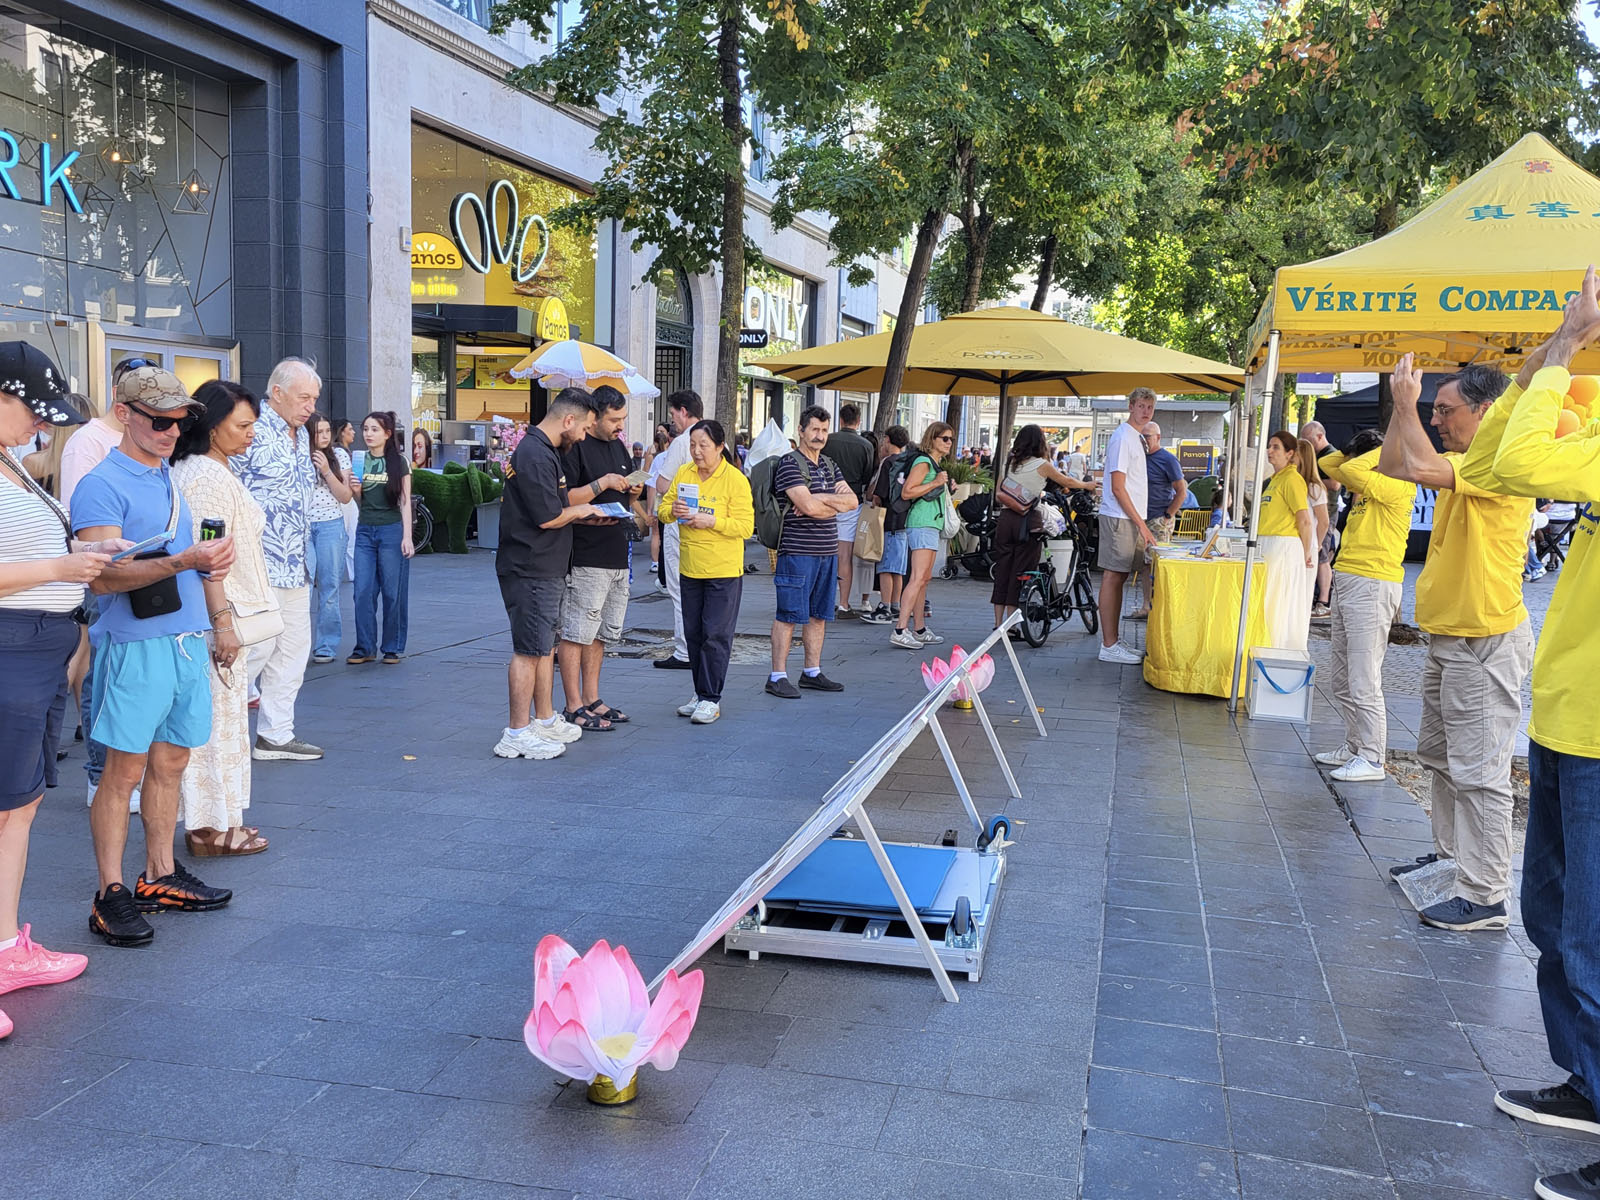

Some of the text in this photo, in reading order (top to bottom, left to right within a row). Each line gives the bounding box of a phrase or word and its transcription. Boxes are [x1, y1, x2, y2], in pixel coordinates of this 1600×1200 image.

[1286, 283, 1417, 312] VÉRITÉ
[545, 318, 567, 339] Panos
[744, 286, 808, 347] ONLY
[962, 352, 1035, 360] Panos
